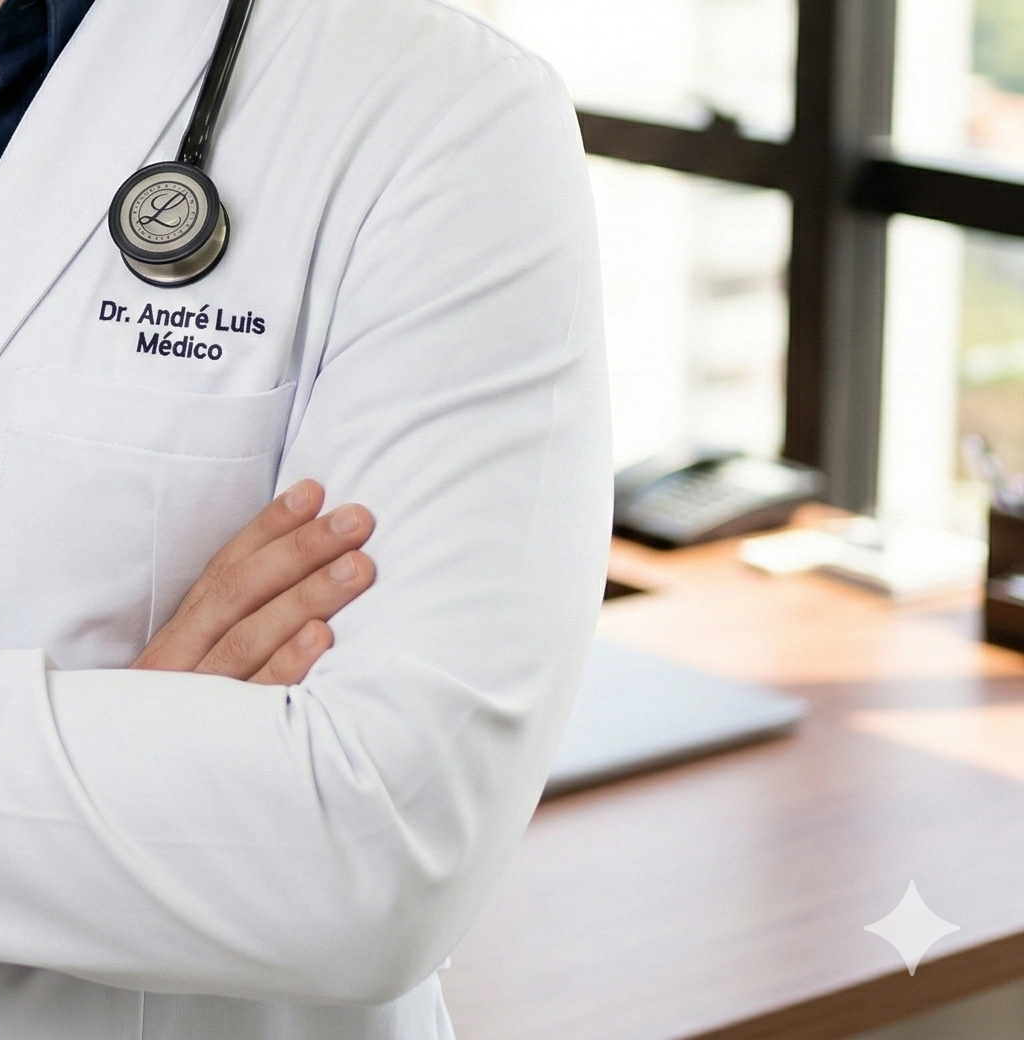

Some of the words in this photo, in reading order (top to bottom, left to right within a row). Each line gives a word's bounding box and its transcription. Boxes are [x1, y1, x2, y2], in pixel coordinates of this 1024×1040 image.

[99, 300, 130, 322] Dr.
[137, 303, 209, 329] André
[215, 309, 266, 334] Luis
[136, 332, 222, 360] Médico
